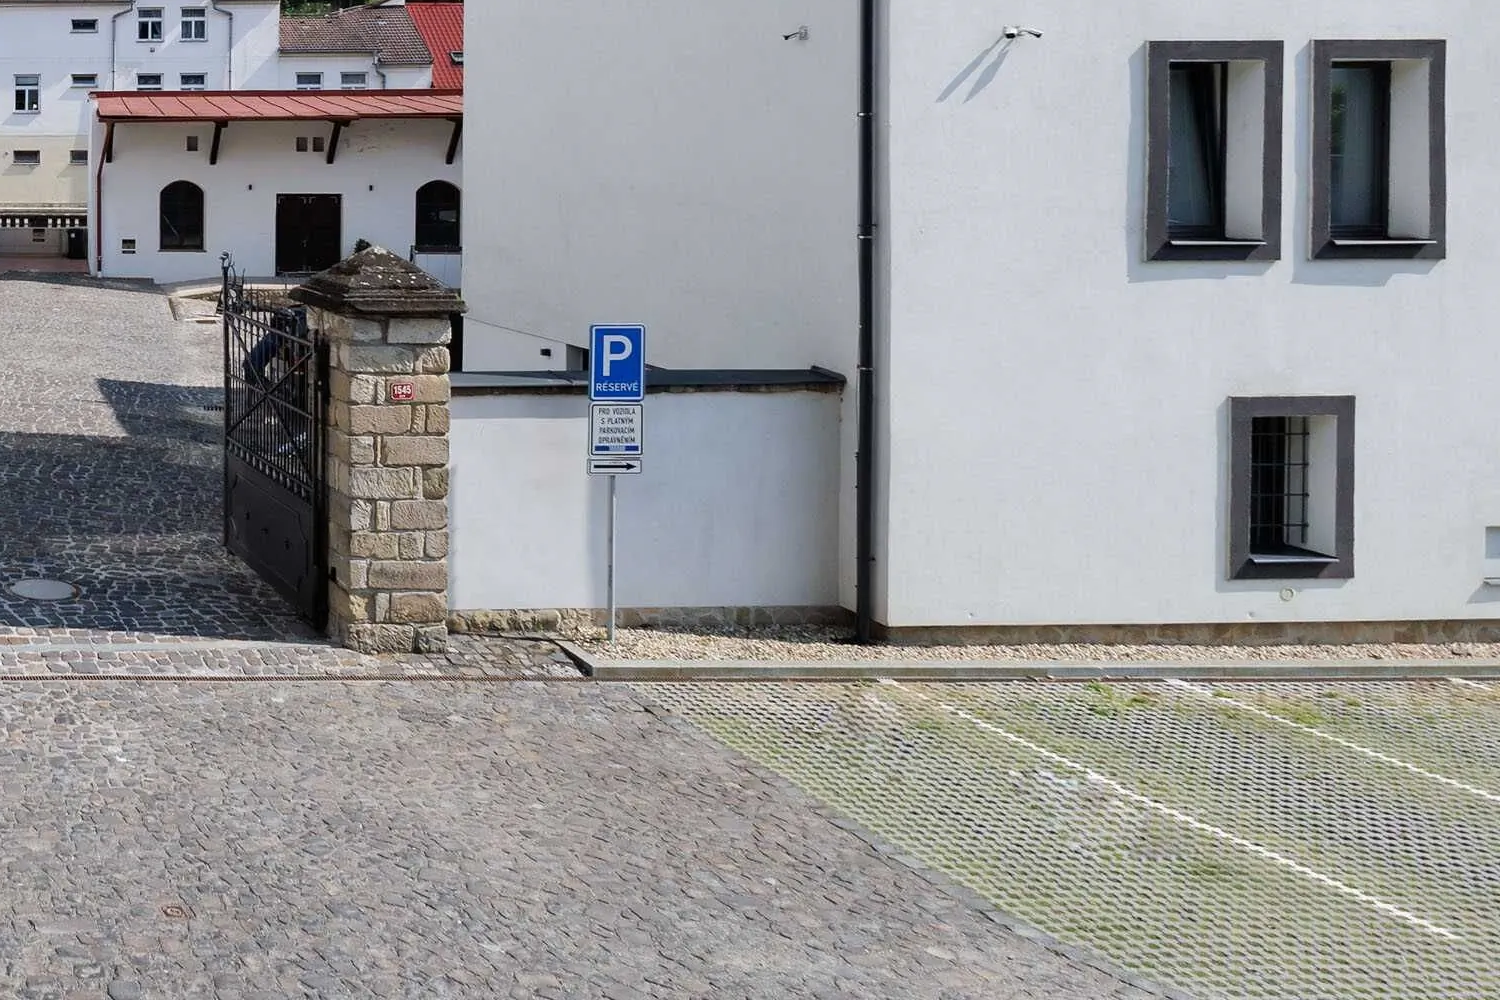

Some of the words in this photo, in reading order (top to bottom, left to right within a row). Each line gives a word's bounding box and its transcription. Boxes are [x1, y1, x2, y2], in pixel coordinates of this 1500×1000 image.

[602, 335, 633, 376] P
[596, 381, 639, 392] RÉSERVÉ
[598, 407, 610, 415] PRO
[600, 417, 605, 425] S
